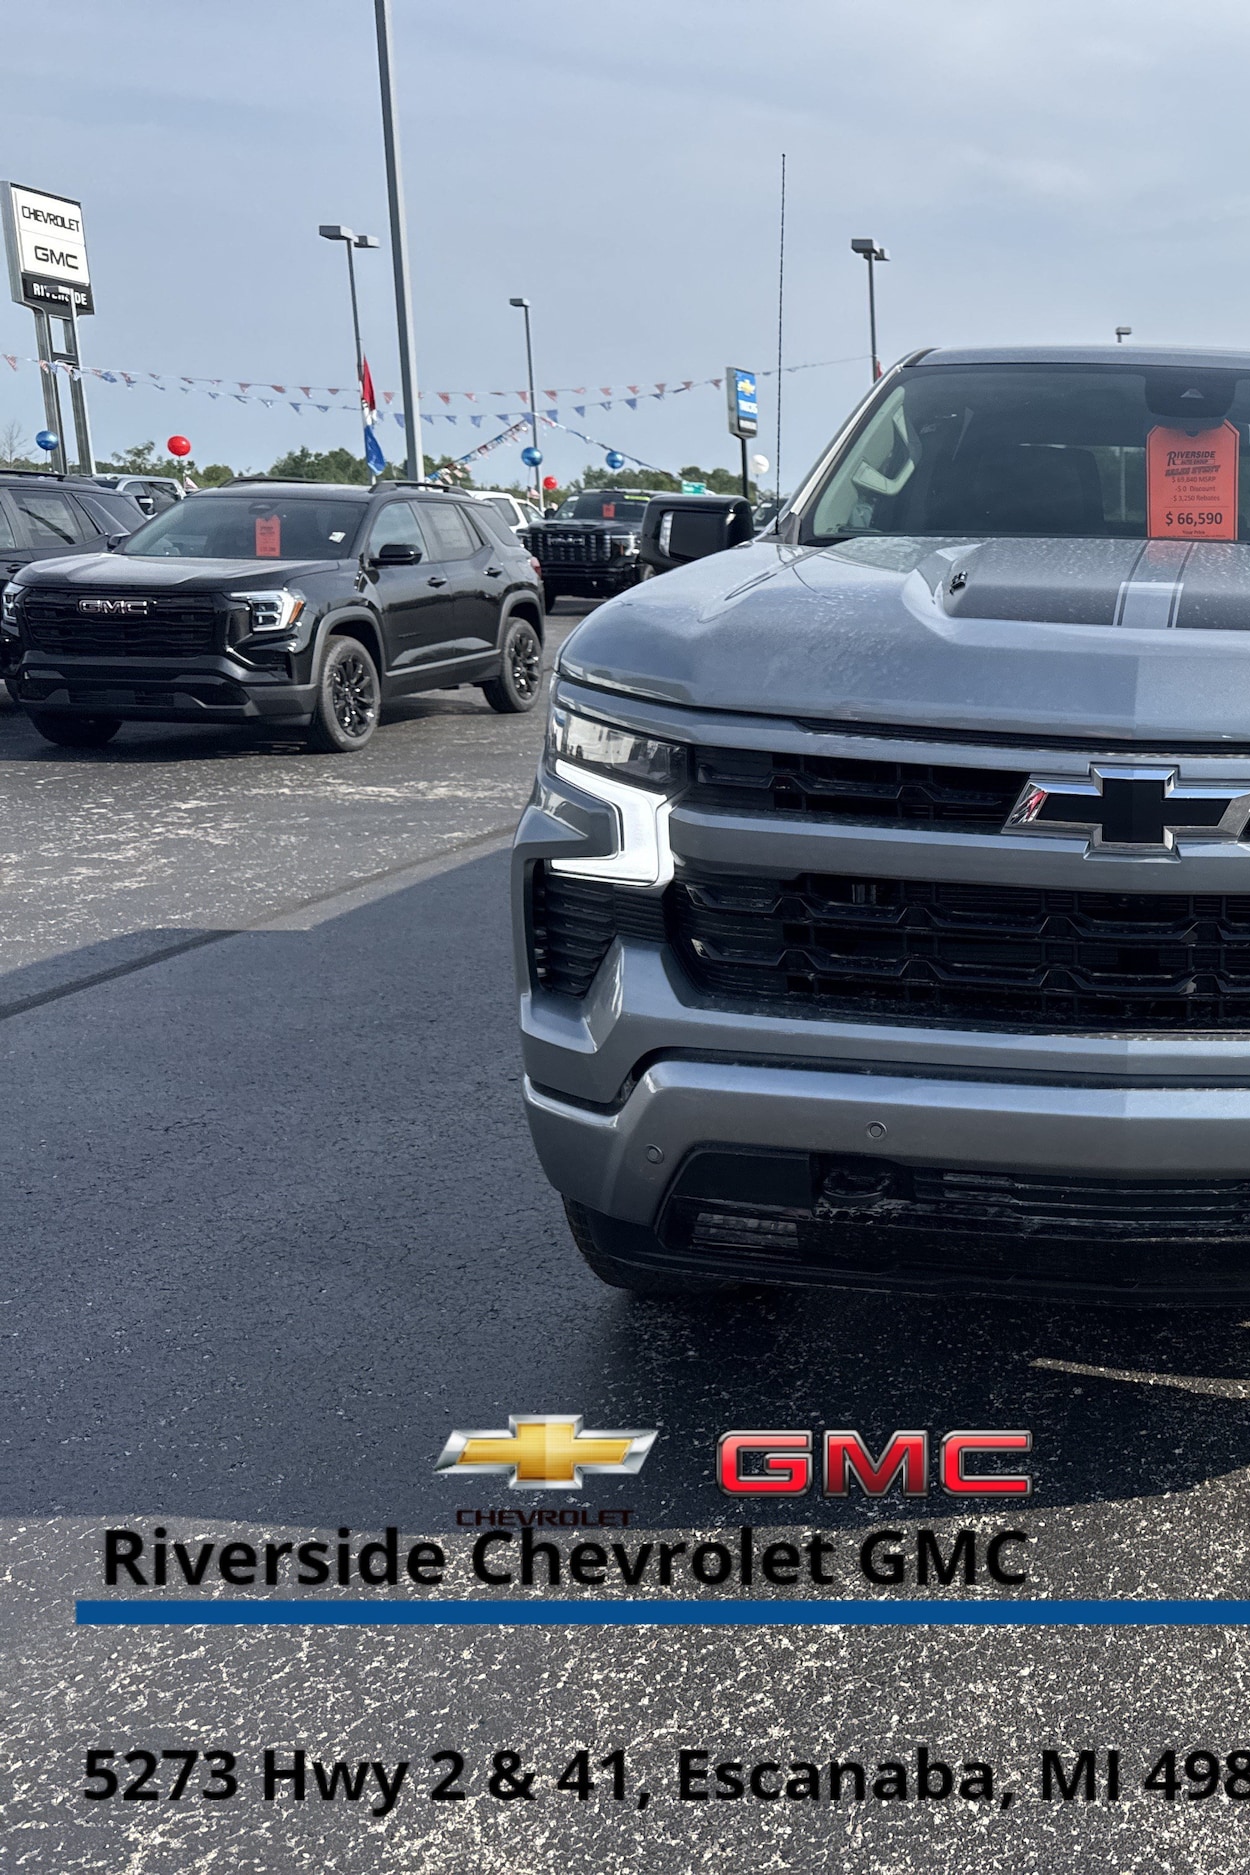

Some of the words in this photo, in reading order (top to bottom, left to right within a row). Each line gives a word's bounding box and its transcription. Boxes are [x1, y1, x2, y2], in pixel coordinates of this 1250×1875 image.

[21, 205, 80, 233] CHEVROLET
[34, 245, 79, 270] GMC
[1167, 450, 1216, 467] RIVERSIDE
[1165, 510, 1173, 526] $
[1177, 512, 1223, 527] 66,590
[79, 599, 148, 615] GMC
